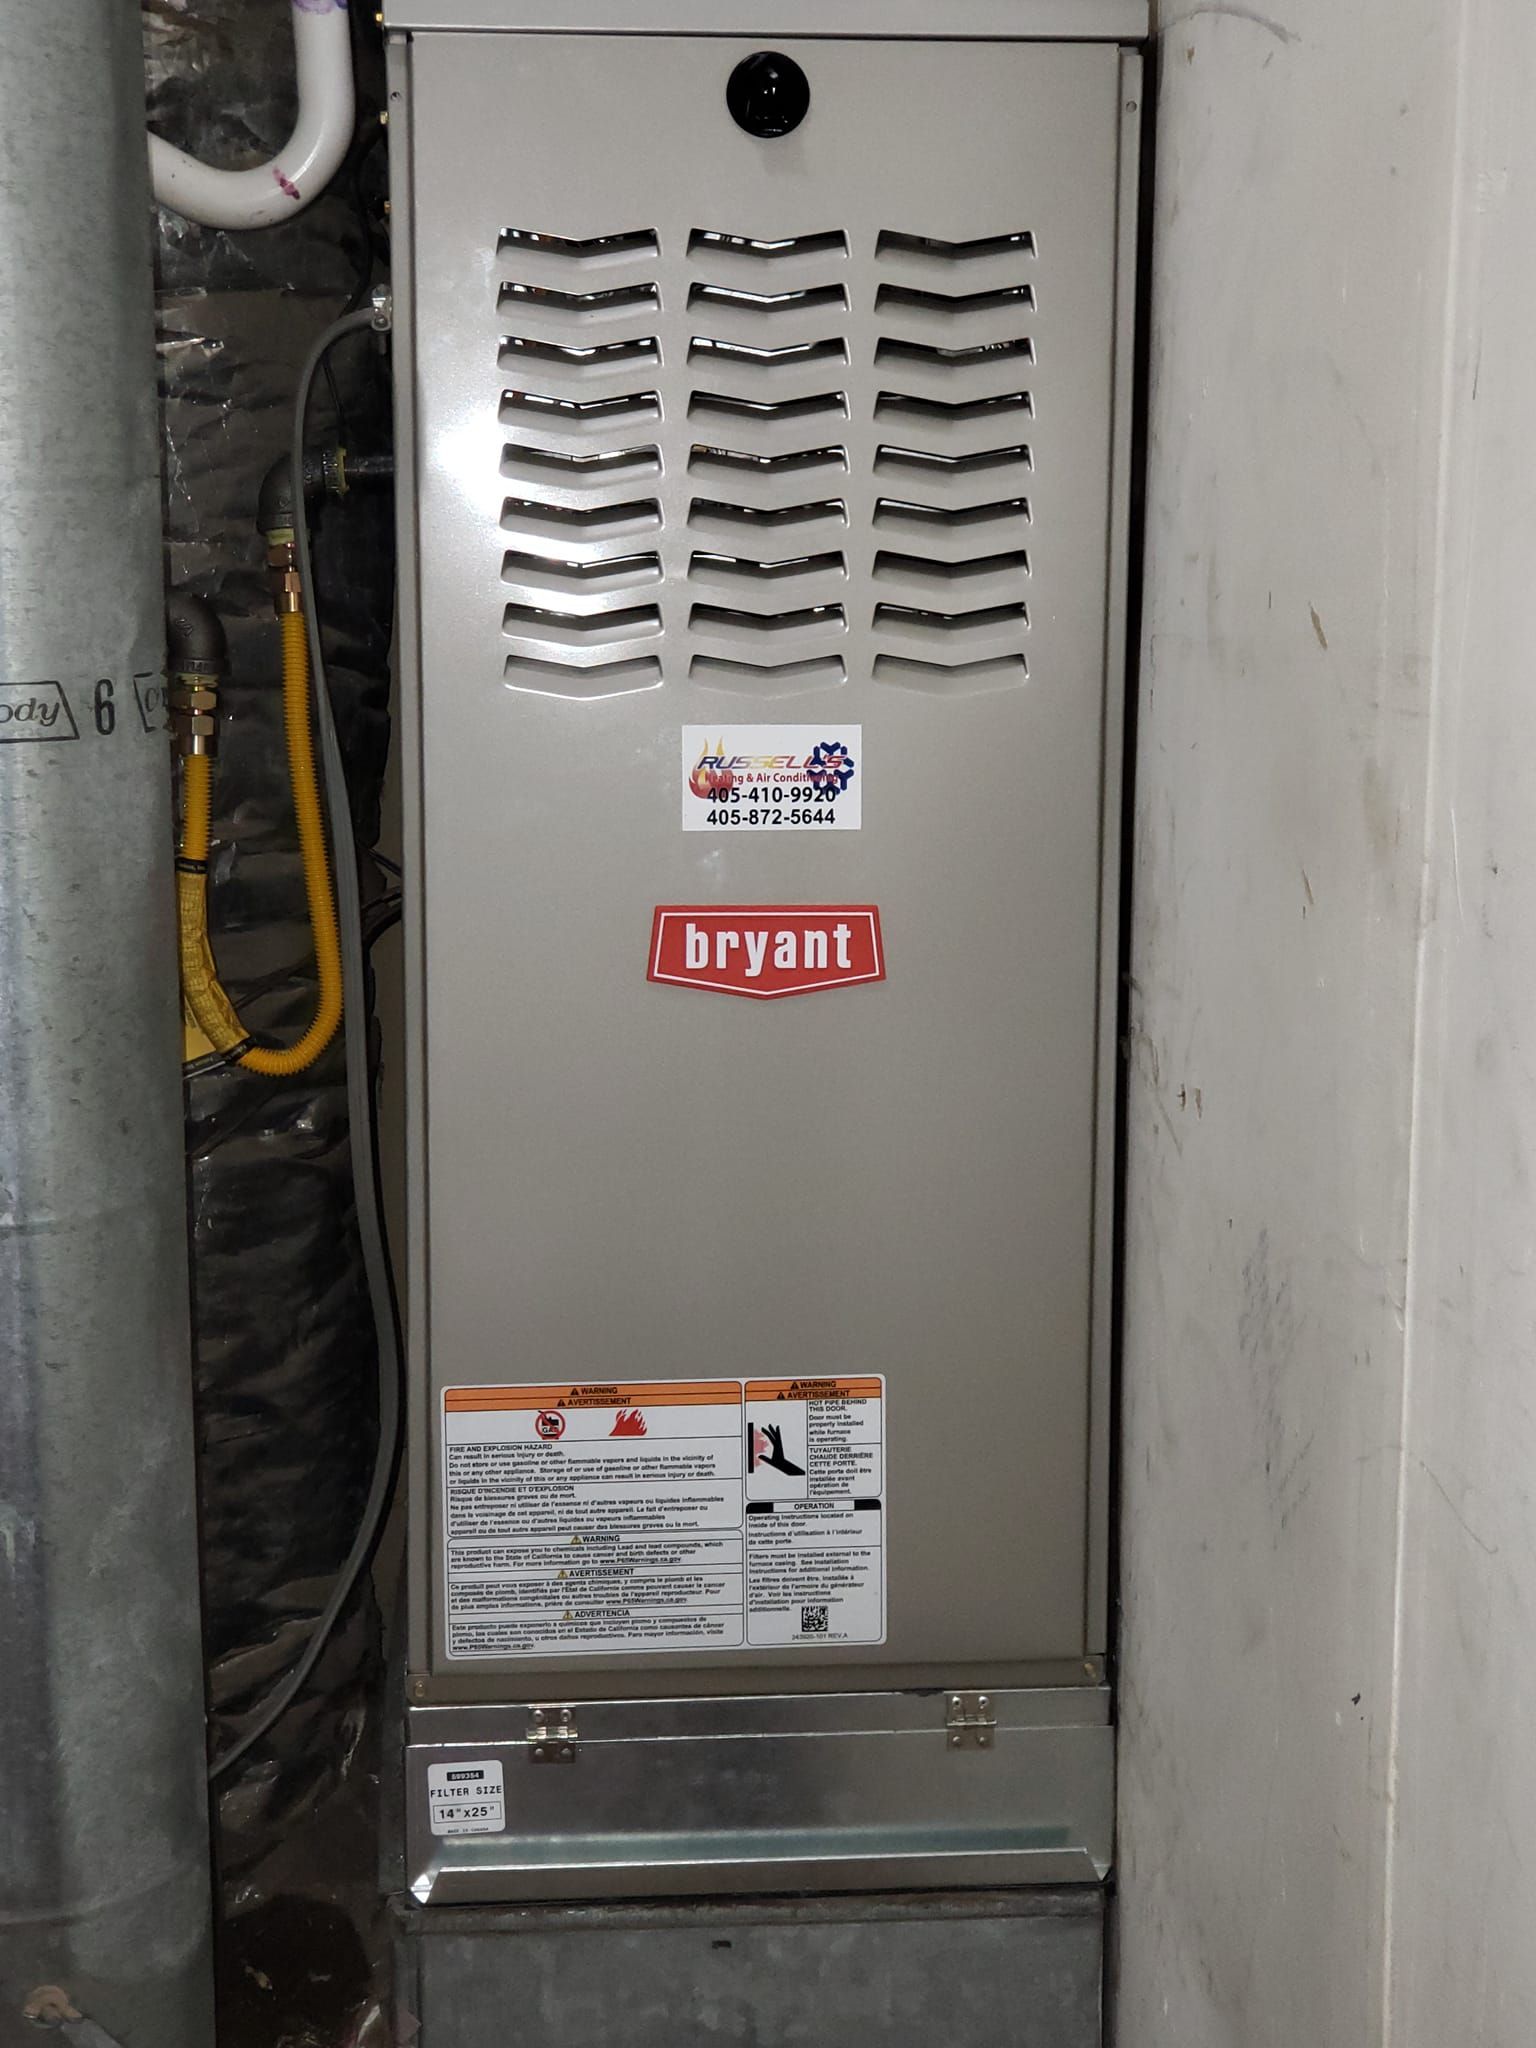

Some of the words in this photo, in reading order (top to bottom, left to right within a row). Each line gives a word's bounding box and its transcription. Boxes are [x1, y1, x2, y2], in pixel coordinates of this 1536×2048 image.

[94, 679, 116, 735] 6
[697, 755, 846, 769] RUSSELL'S
[705, 773, 743, 785] Heating
[746, 773, 753, 783] &
[756, 773, 770, 783] Air
[775, 772, 838, 785] Conditioning
[707, 786, 836, 804] 405-410-9920
[707, 808, 836, 826] 405-872-5644
[685, 923, 852, 977] bryant
[800, 1381, 837, 1389] WARNING
[581, 1387, 618, 1395] WARNING
[787, 1390, 850, 1399] AVERTISSEMENT
[568, 1397, 632, 1406] AVERTISSEMENT
[809, 1420, 835, 1428] properly
[517, 1452, 535, 1460] injury
[512, 1460, 539, 1468] gasoline
[640, 1456, 661, 1464] liquids
[682, 1455, 704, 1463] vicinity
[540, 1467, 564, 1475] Storage
[604, 1465, 631, 1473] gasoline
[458, 1478, 479, 1486] liquids
[501, 1476, 524, 1484] vicinity
[569, 1474, 600, 1482] appliance
[667, 1471, 686, 1479] injury
[749, 1514, 780, 1522] Operating
[582, 1535, 620, 1543] WARNING
[569, 1568, 634, 1577] AVERTISSEMENT
[575, 1609, 631, 1618] ADVERTENCIA
[430, 1787, 469, 1798] FILTER
[476, 1785, 502, 1795] SIZE
